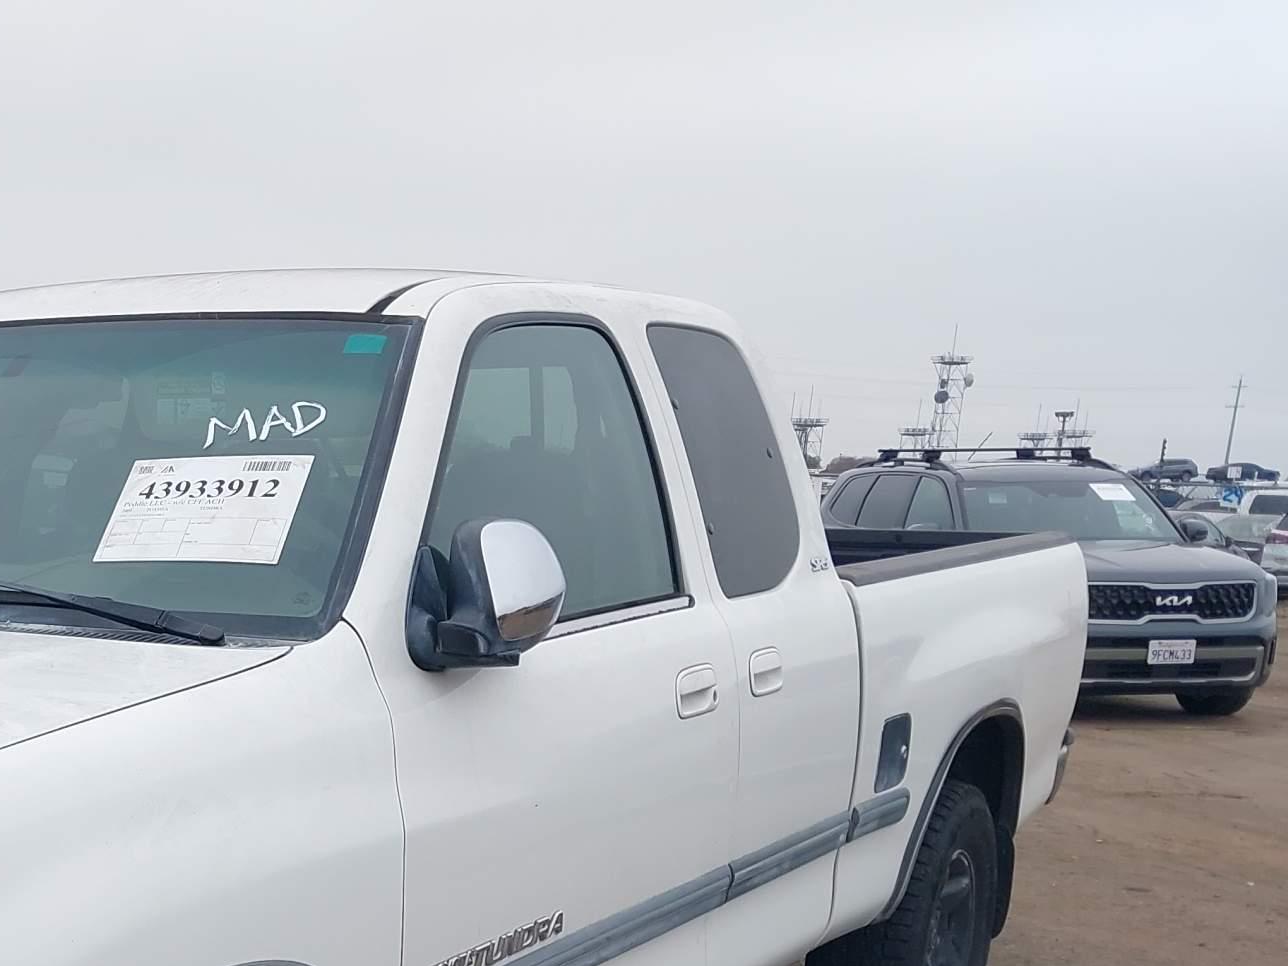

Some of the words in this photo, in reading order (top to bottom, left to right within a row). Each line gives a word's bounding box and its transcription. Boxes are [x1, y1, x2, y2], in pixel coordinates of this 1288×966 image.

[203, 401, 327, 449] MAD
[138, 478, 280, 499] 43933912
[1156, 596, 1193, 606] KIA
[1151, 649, 1192, 661] 9FCM433
